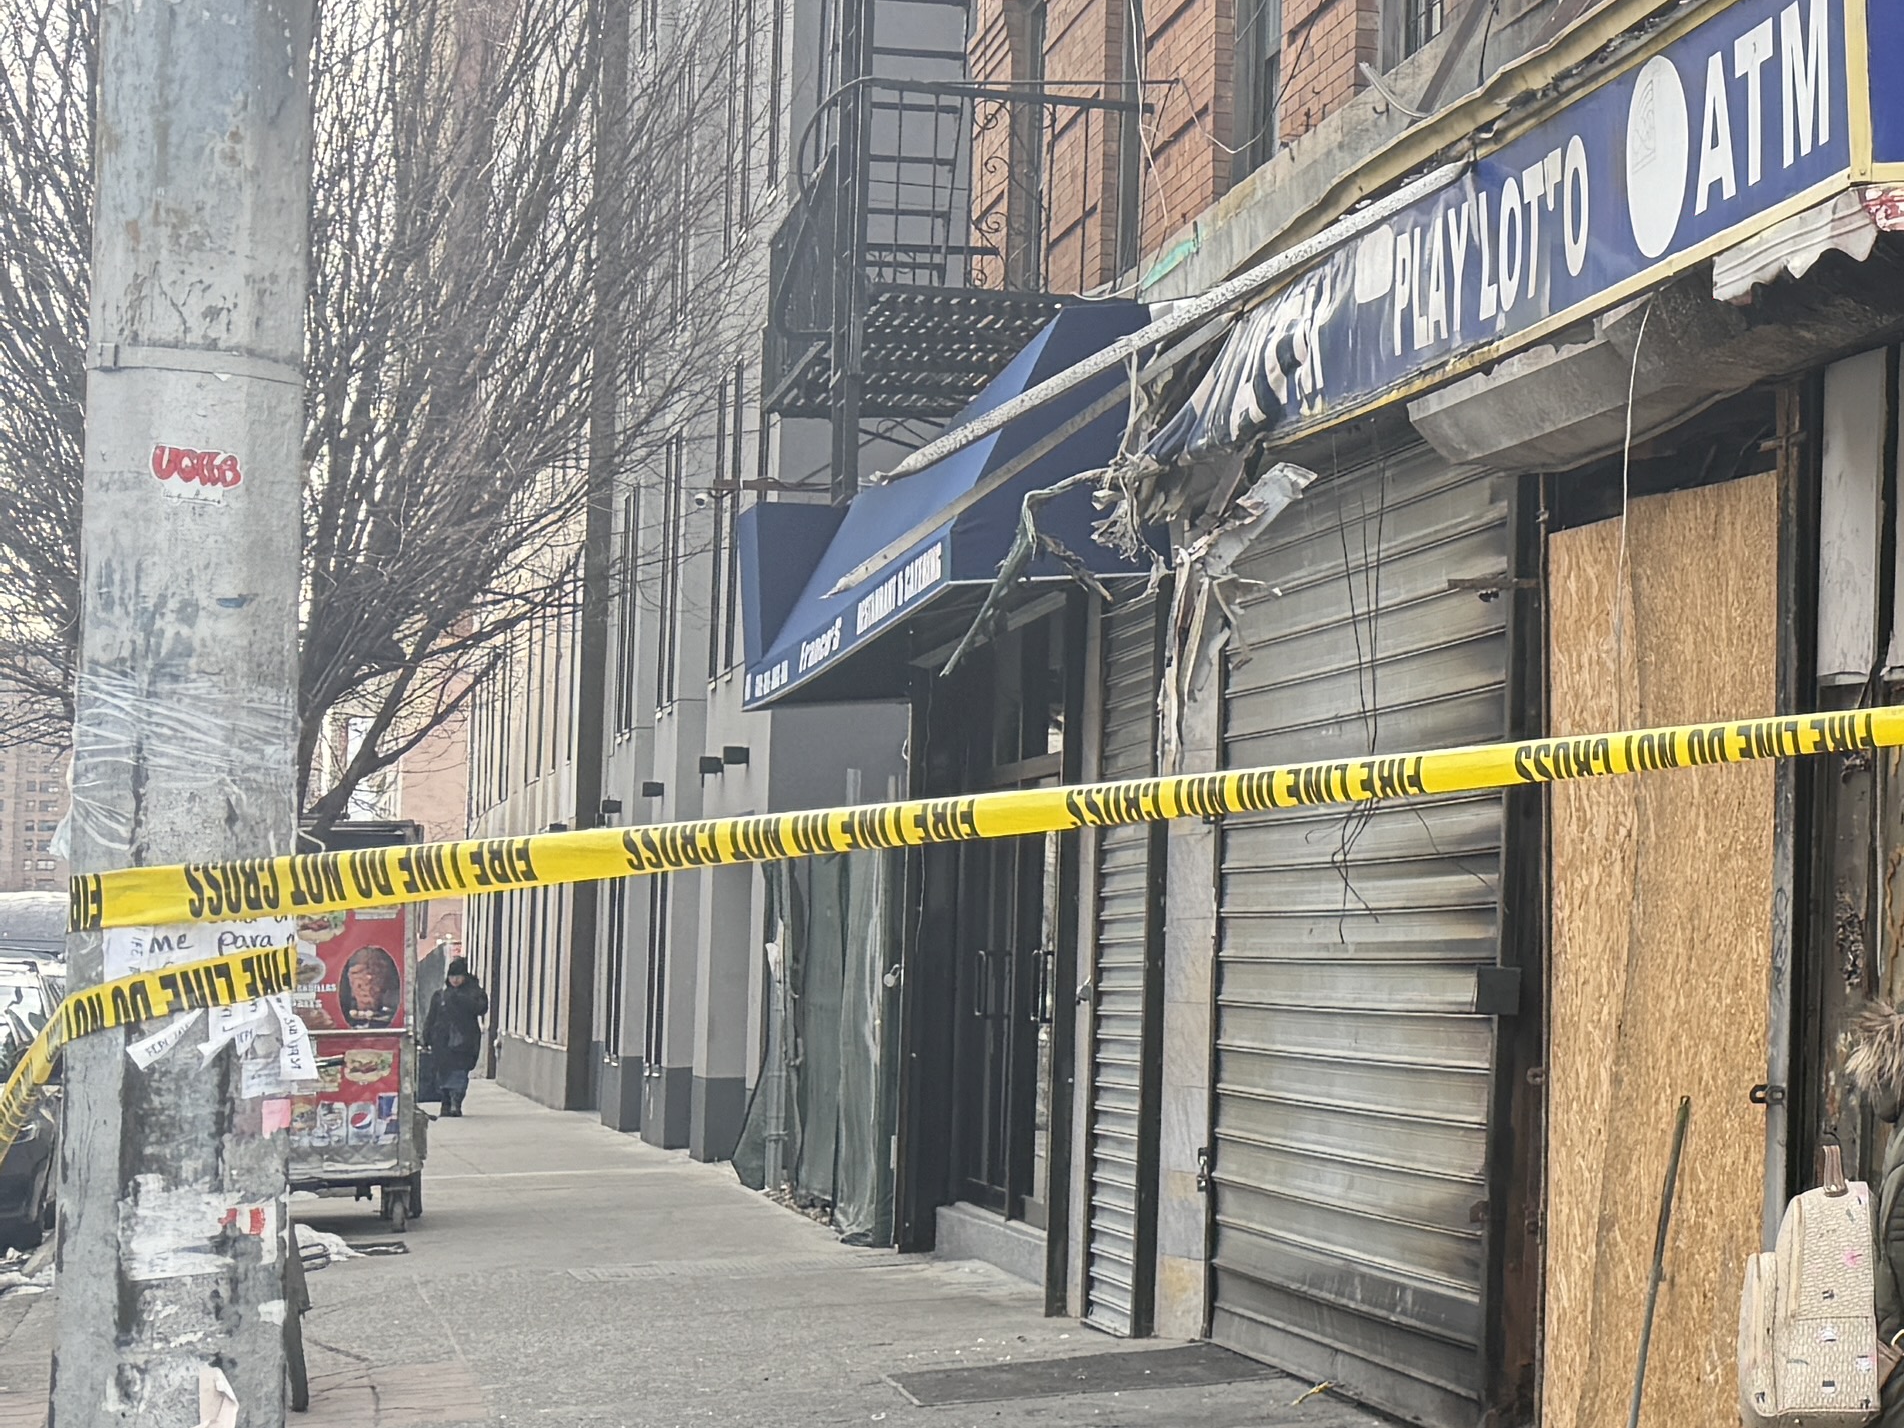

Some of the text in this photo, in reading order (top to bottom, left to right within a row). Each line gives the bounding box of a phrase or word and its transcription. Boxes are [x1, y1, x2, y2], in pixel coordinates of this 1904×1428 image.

[1393, 204, 1470, 357] PLAY
[1513, 736, 1615, 783] CROSS
[1624, 730, 1682, 775] NOT
[1687, 726, 1730, 767] DO
[1735, 718, 1800, 760] LINE
[729, 815, 790, 863] NOT
[791, 810, 835, 856] DO
[914, 797, 980, 845] FIRE
[622, 822, 722, 872] CROSS
[183, 836, 539, 919] FIRE LINE DO NOT CROSS
[69, 871, 101, 934] FIR
[158, 961, 237, 1014] LINE
[241, 945, 293, 999] FIRE
[111, 979, 154, 1028] DO
